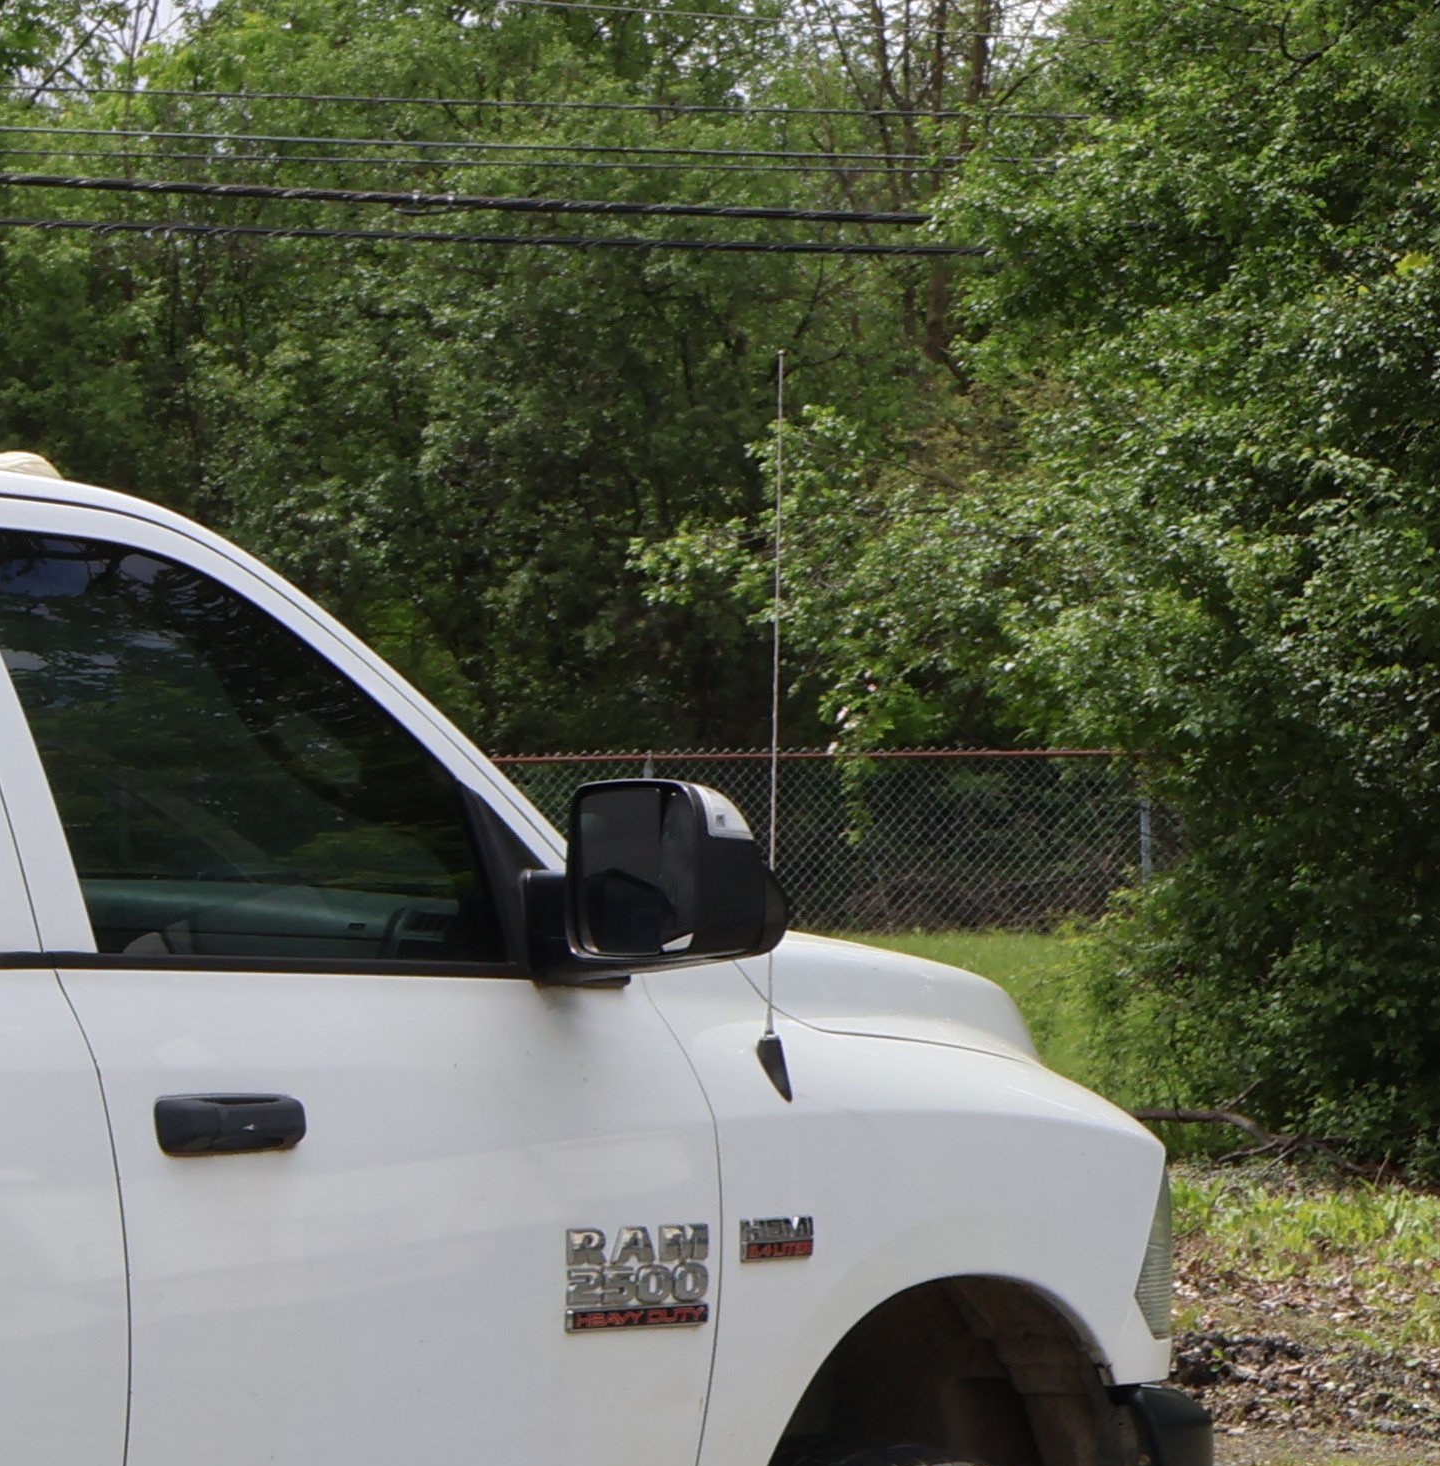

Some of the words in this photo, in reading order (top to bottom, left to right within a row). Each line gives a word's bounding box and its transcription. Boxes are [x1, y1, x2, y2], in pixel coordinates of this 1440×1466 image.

[566, 1224, 709, 1266] RAM
[740, 1216, 814, 1243] HEMI
[566, 1262, 709, 1306] 2500
[576, 1310, 644, 1327] HEAVY
[647, 1307, 705, 1323] DUTY
